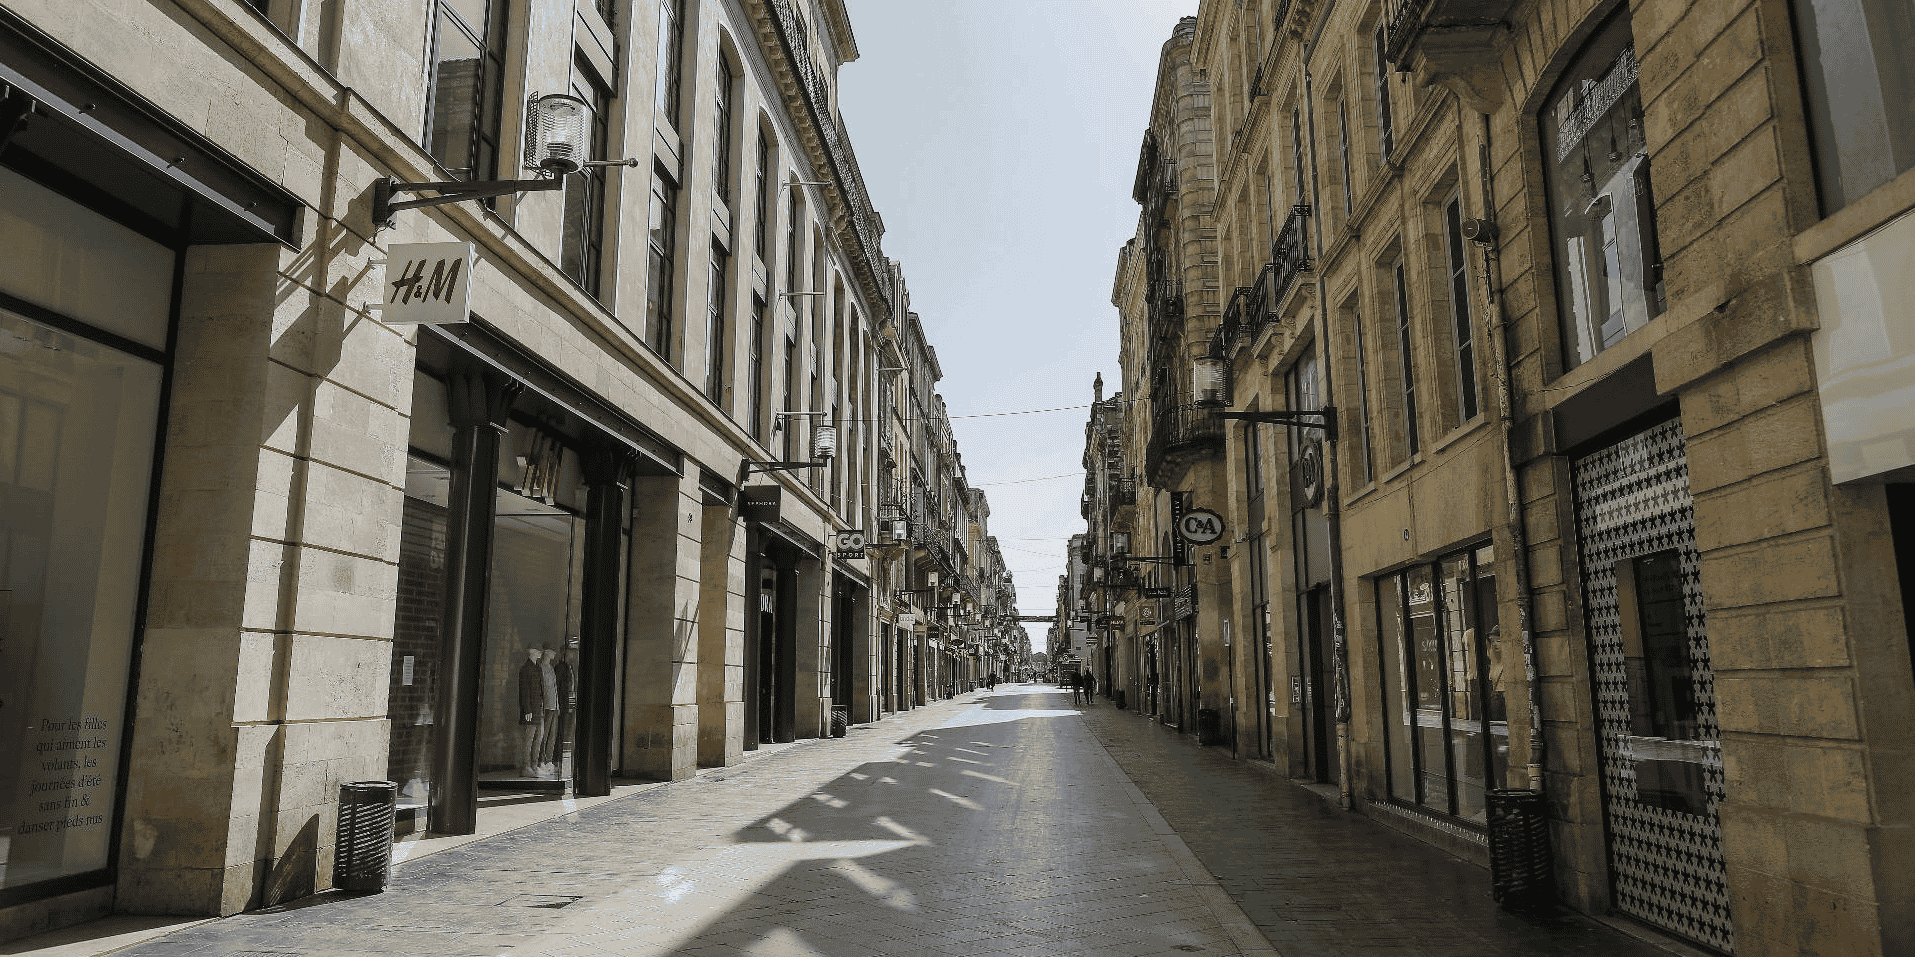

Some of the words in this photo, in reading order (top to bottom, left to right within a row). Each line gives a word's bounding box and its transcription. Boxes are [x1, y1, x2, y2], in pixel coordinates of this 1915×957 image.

[391, 258, 463, 305] H&M
[1184, 516, 1218, 535] C&A
[836, 533, 865, 550] GO
[41, 719, 65, 732] Pour
[68, 719, 81, 731] les
[84, 717, 108, 730] filles
[36, 738, 54, 755] qui
[56, 738, 91, 751] aiment
[93, 736, 107, 749] les
[84, 755, 98, 768] les
[38, 801, 61, 812] sans
[64, 796, 78, 809] fin
[80, 793, 91, 807] &
[18, 820, 54, 835] danser
[56, 815, 83, 833] pieds
[85, 814, 104, 826] nus
